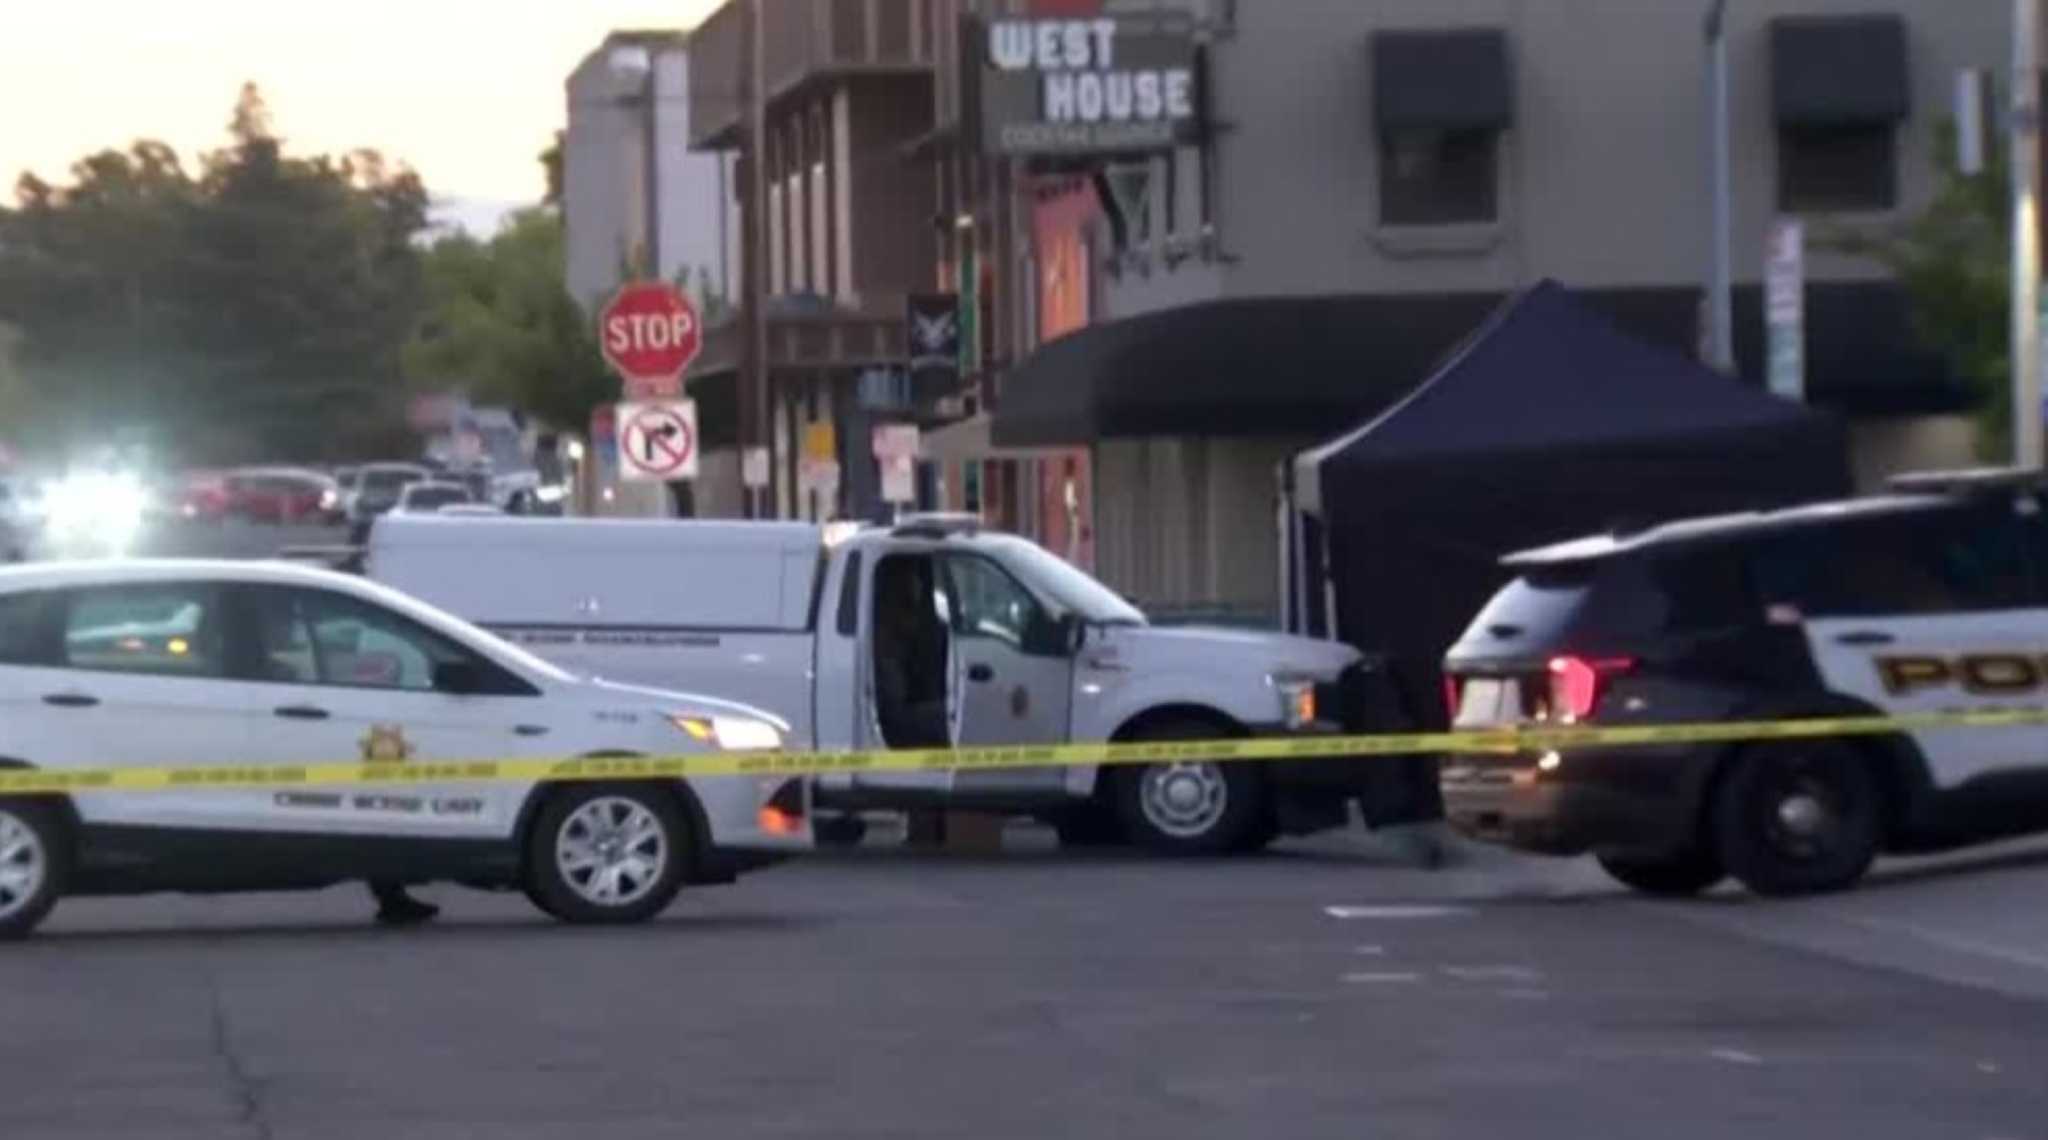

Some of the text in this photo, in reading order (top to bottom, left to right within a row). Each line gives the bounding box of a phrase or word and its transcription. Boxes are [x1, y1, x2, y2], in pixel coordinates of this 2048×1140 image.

[990, 20, 1115, 69] WEST
[1045, 71, 1191, 120] HOUSE
[609, 312, 692, 352] STOP
[1875, 655, 2048, 697] PO
